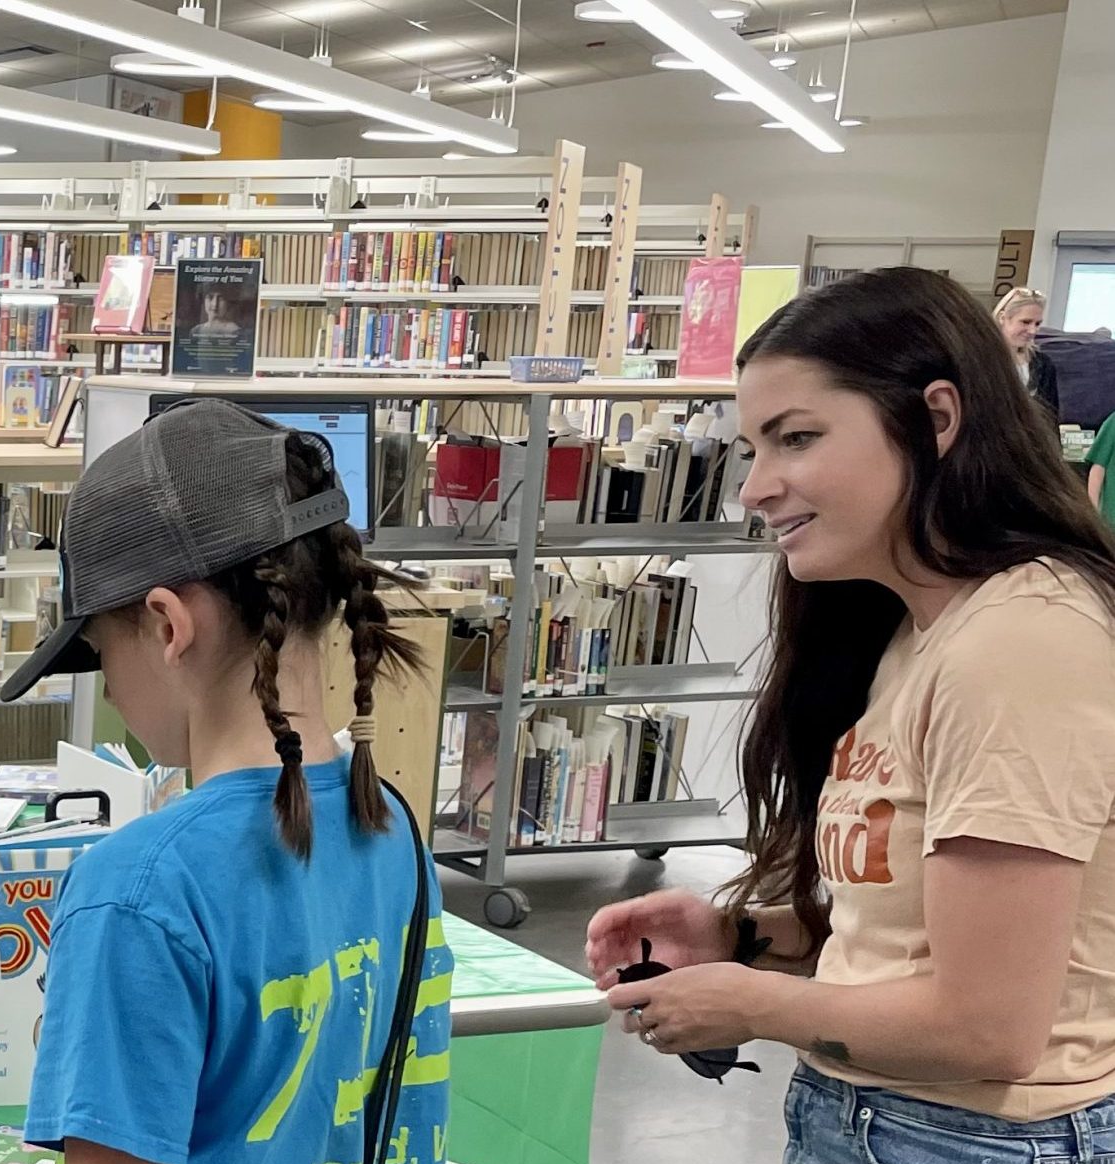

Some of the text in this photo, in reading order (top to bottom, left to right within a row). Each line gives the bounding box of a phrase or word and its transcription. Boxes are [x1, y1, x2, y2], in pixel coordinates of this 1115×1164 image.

[185, 265, 254, 274] Explore the Amazing
[995, 236, 1020, 297] DULT
[194, 274, 244, 283] History of You
[4, 878, 53, 907] you
